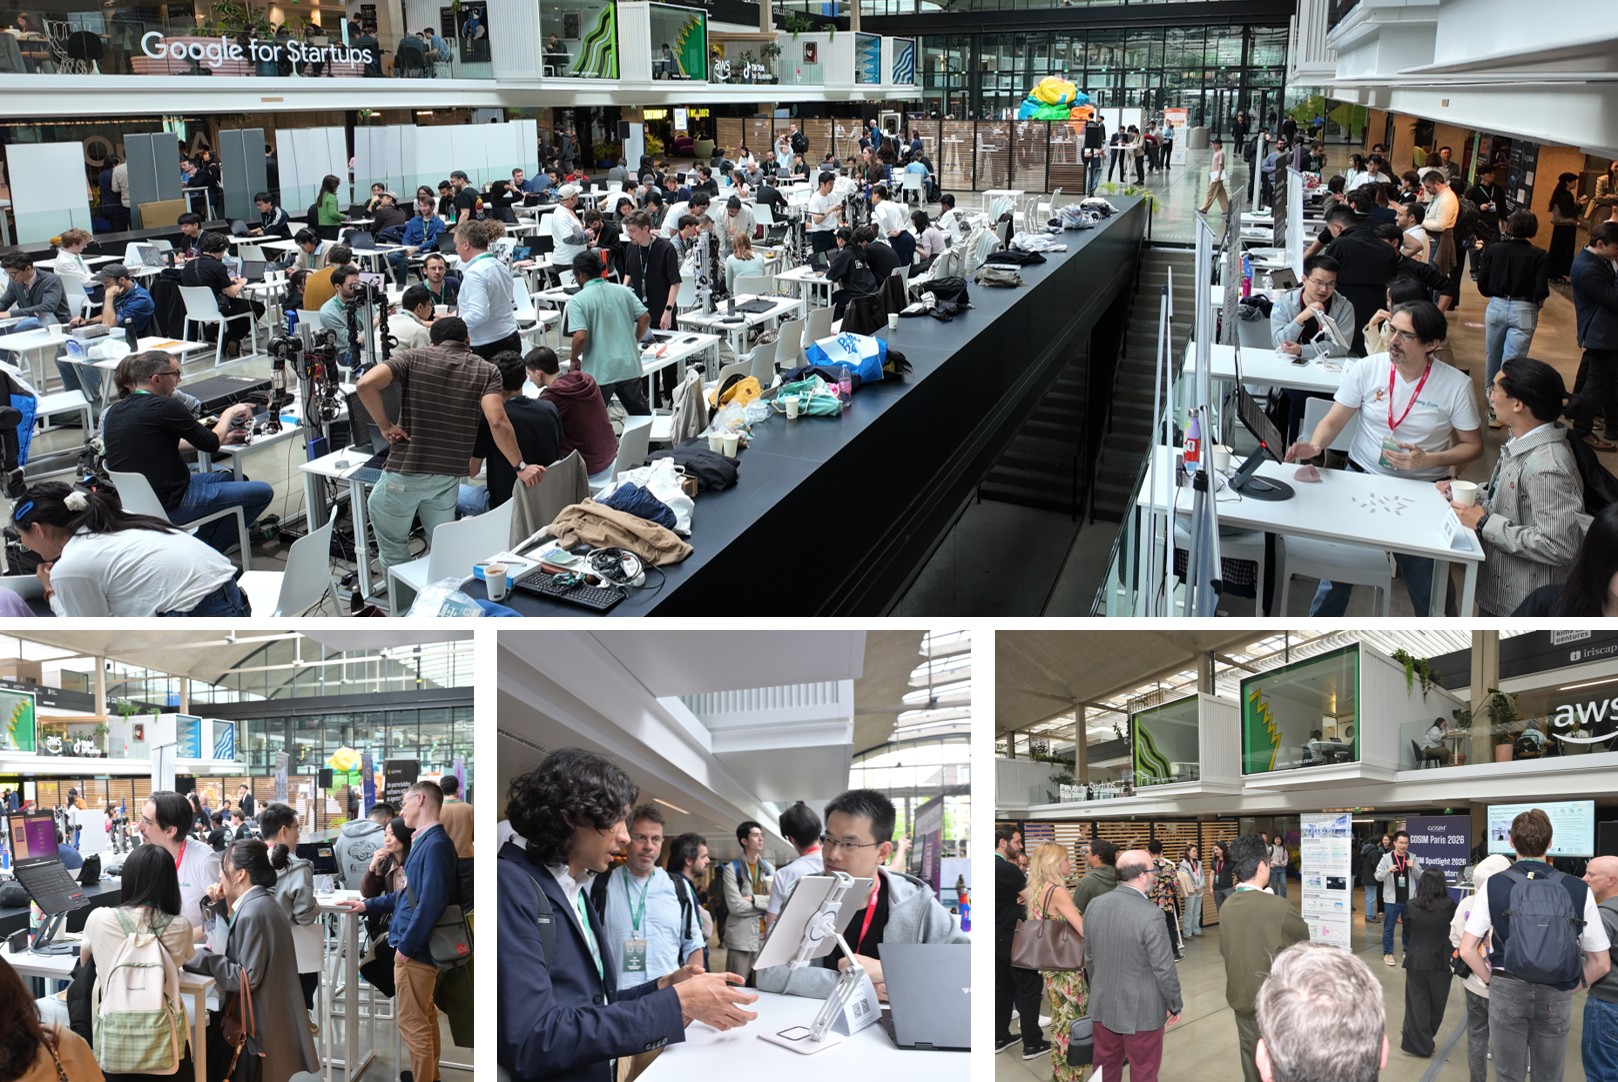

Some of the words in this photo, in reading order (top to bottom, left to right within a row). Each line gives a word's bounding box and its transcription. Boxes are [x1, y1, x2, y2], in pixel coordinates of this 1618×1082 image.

[141, 31, 244, 67] Google
[248, 38, 282, 61] for
[287, 40, 373, 68] Startups
[1556, 631, 1589, 643] ventures
[1583, 645, 1618, 658] iriscap
[1410, 835, 1429, 844] GOSIM
[1430, 835, 1447, 844] Paris
[1447, 835, 1465, 845] 2026
[1425, 857, 1451, 867] Spotlight
[1451, 858, 1467, 866] 2026
